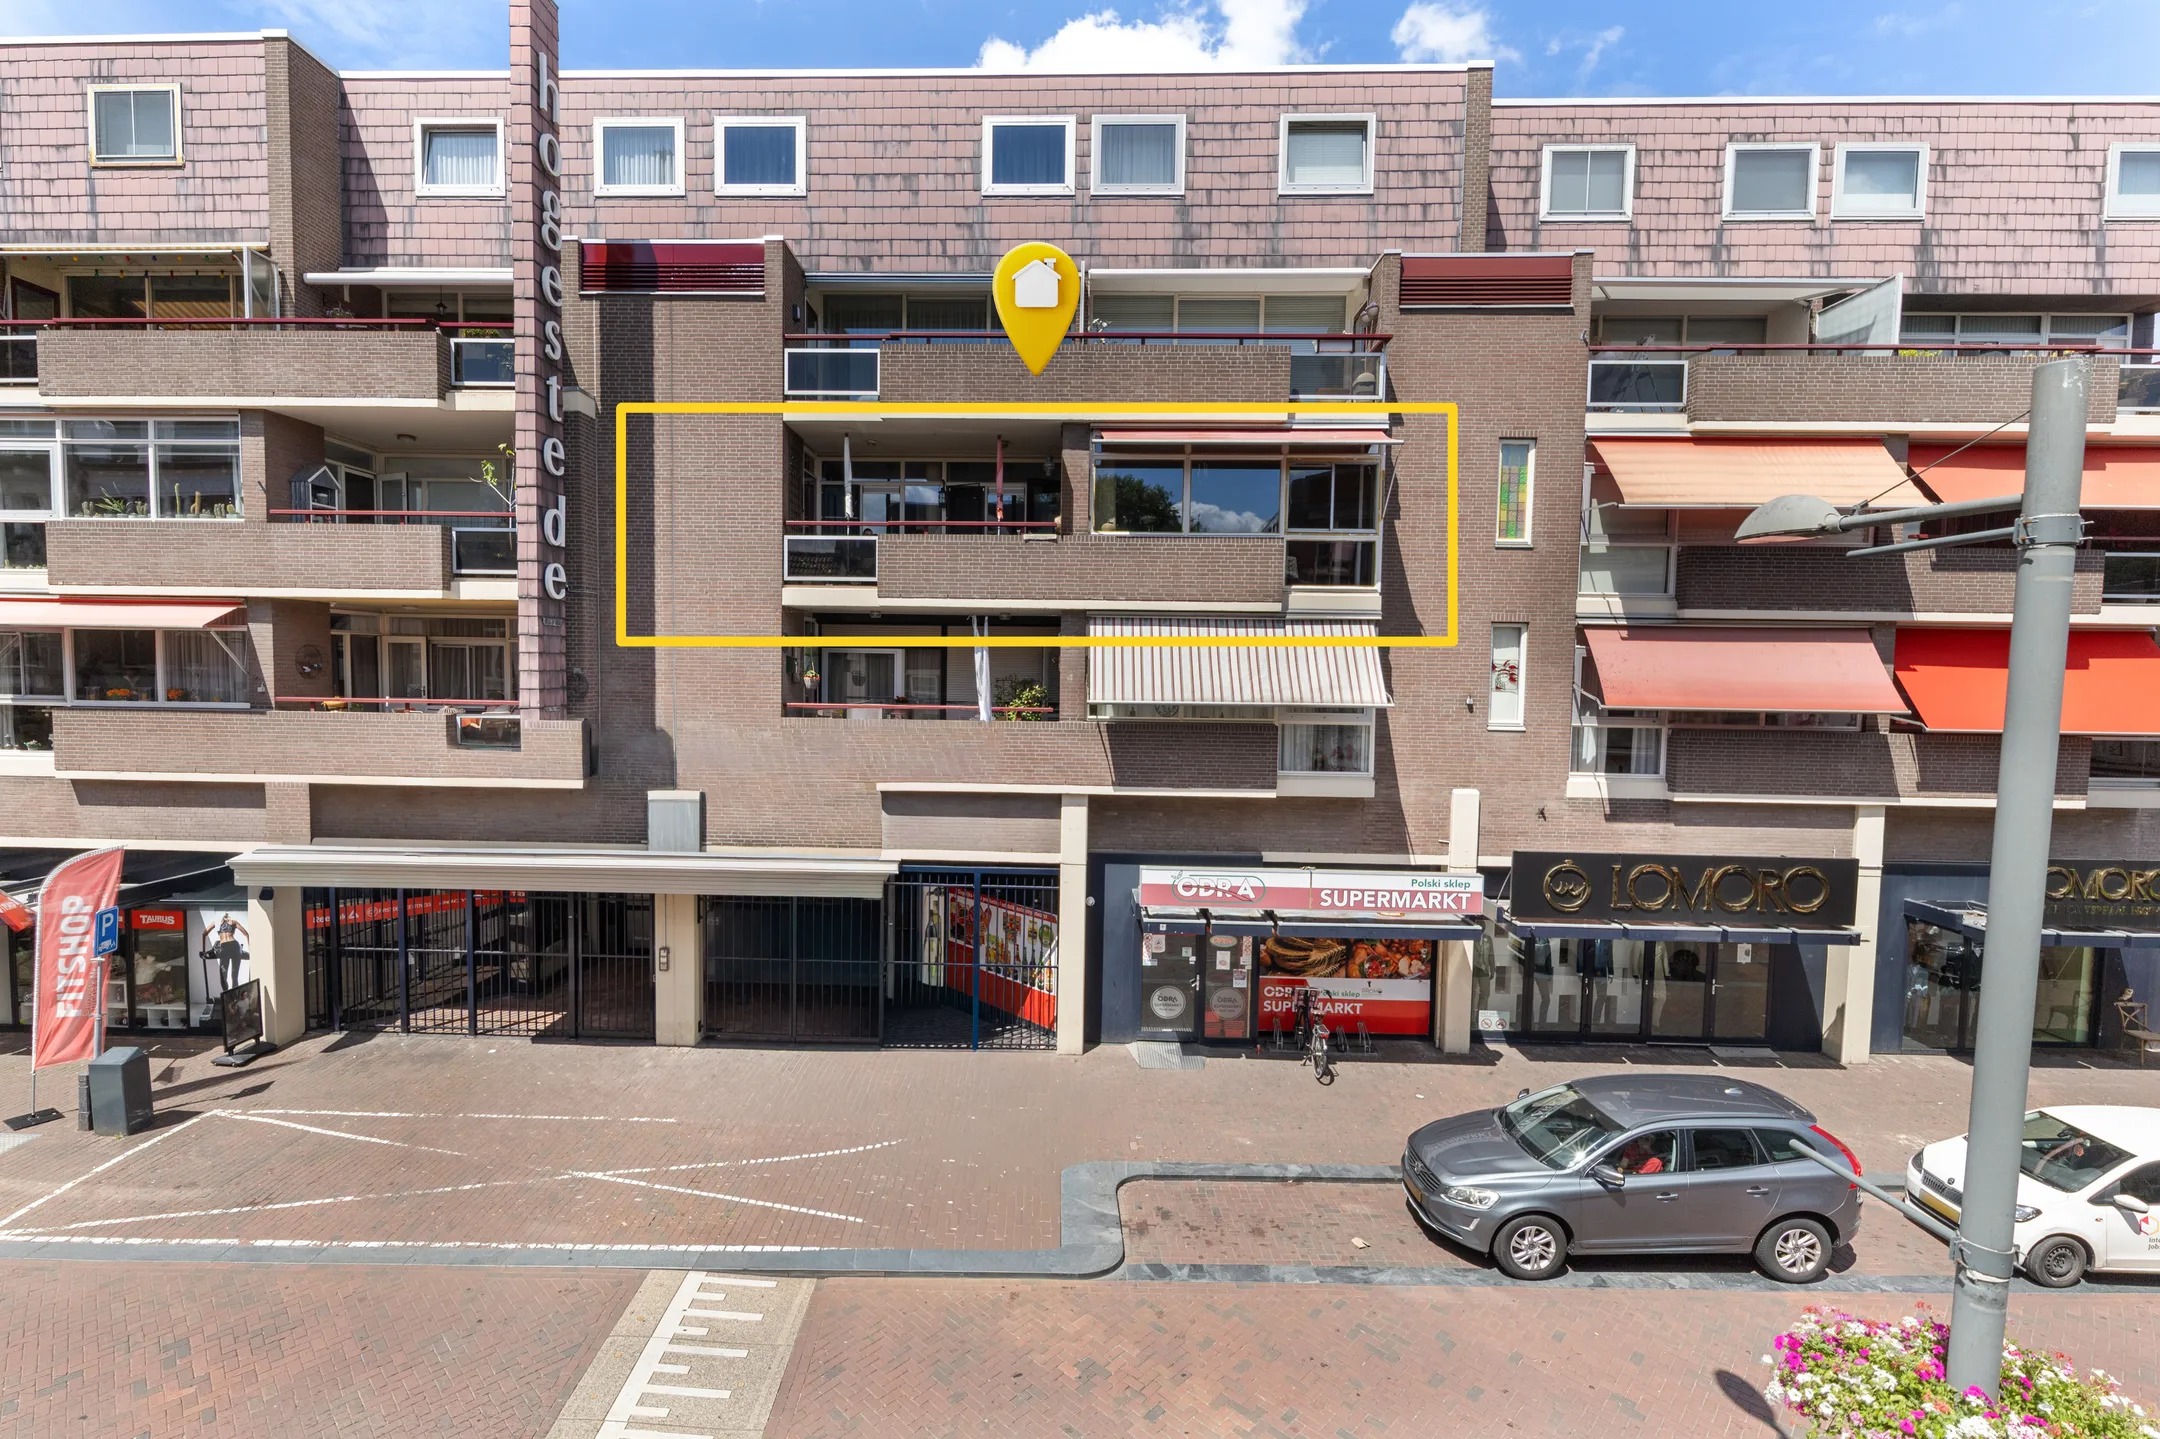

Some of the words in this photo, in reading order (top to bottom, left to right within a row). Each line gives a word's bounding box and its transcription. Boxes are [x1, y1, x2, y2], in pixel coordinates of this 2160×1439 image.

[538, 52, 567, 600] hogestede
[1177, 877, 1256, 899] ODRA
[1411, 878, 1440, 888] Polski
[1443, 879, 1471, 890] sklep
[1611, 864, 1830, 913] LOMORO
[1320, 889, 1471, 910] SUPERMARKT
[101, 913, 114, 937] P
[140, 914, 175, 925] TAURUS
[56, 895, 94, 1018] FITSHOP
[1263, 986, 1293, 998] ODR
